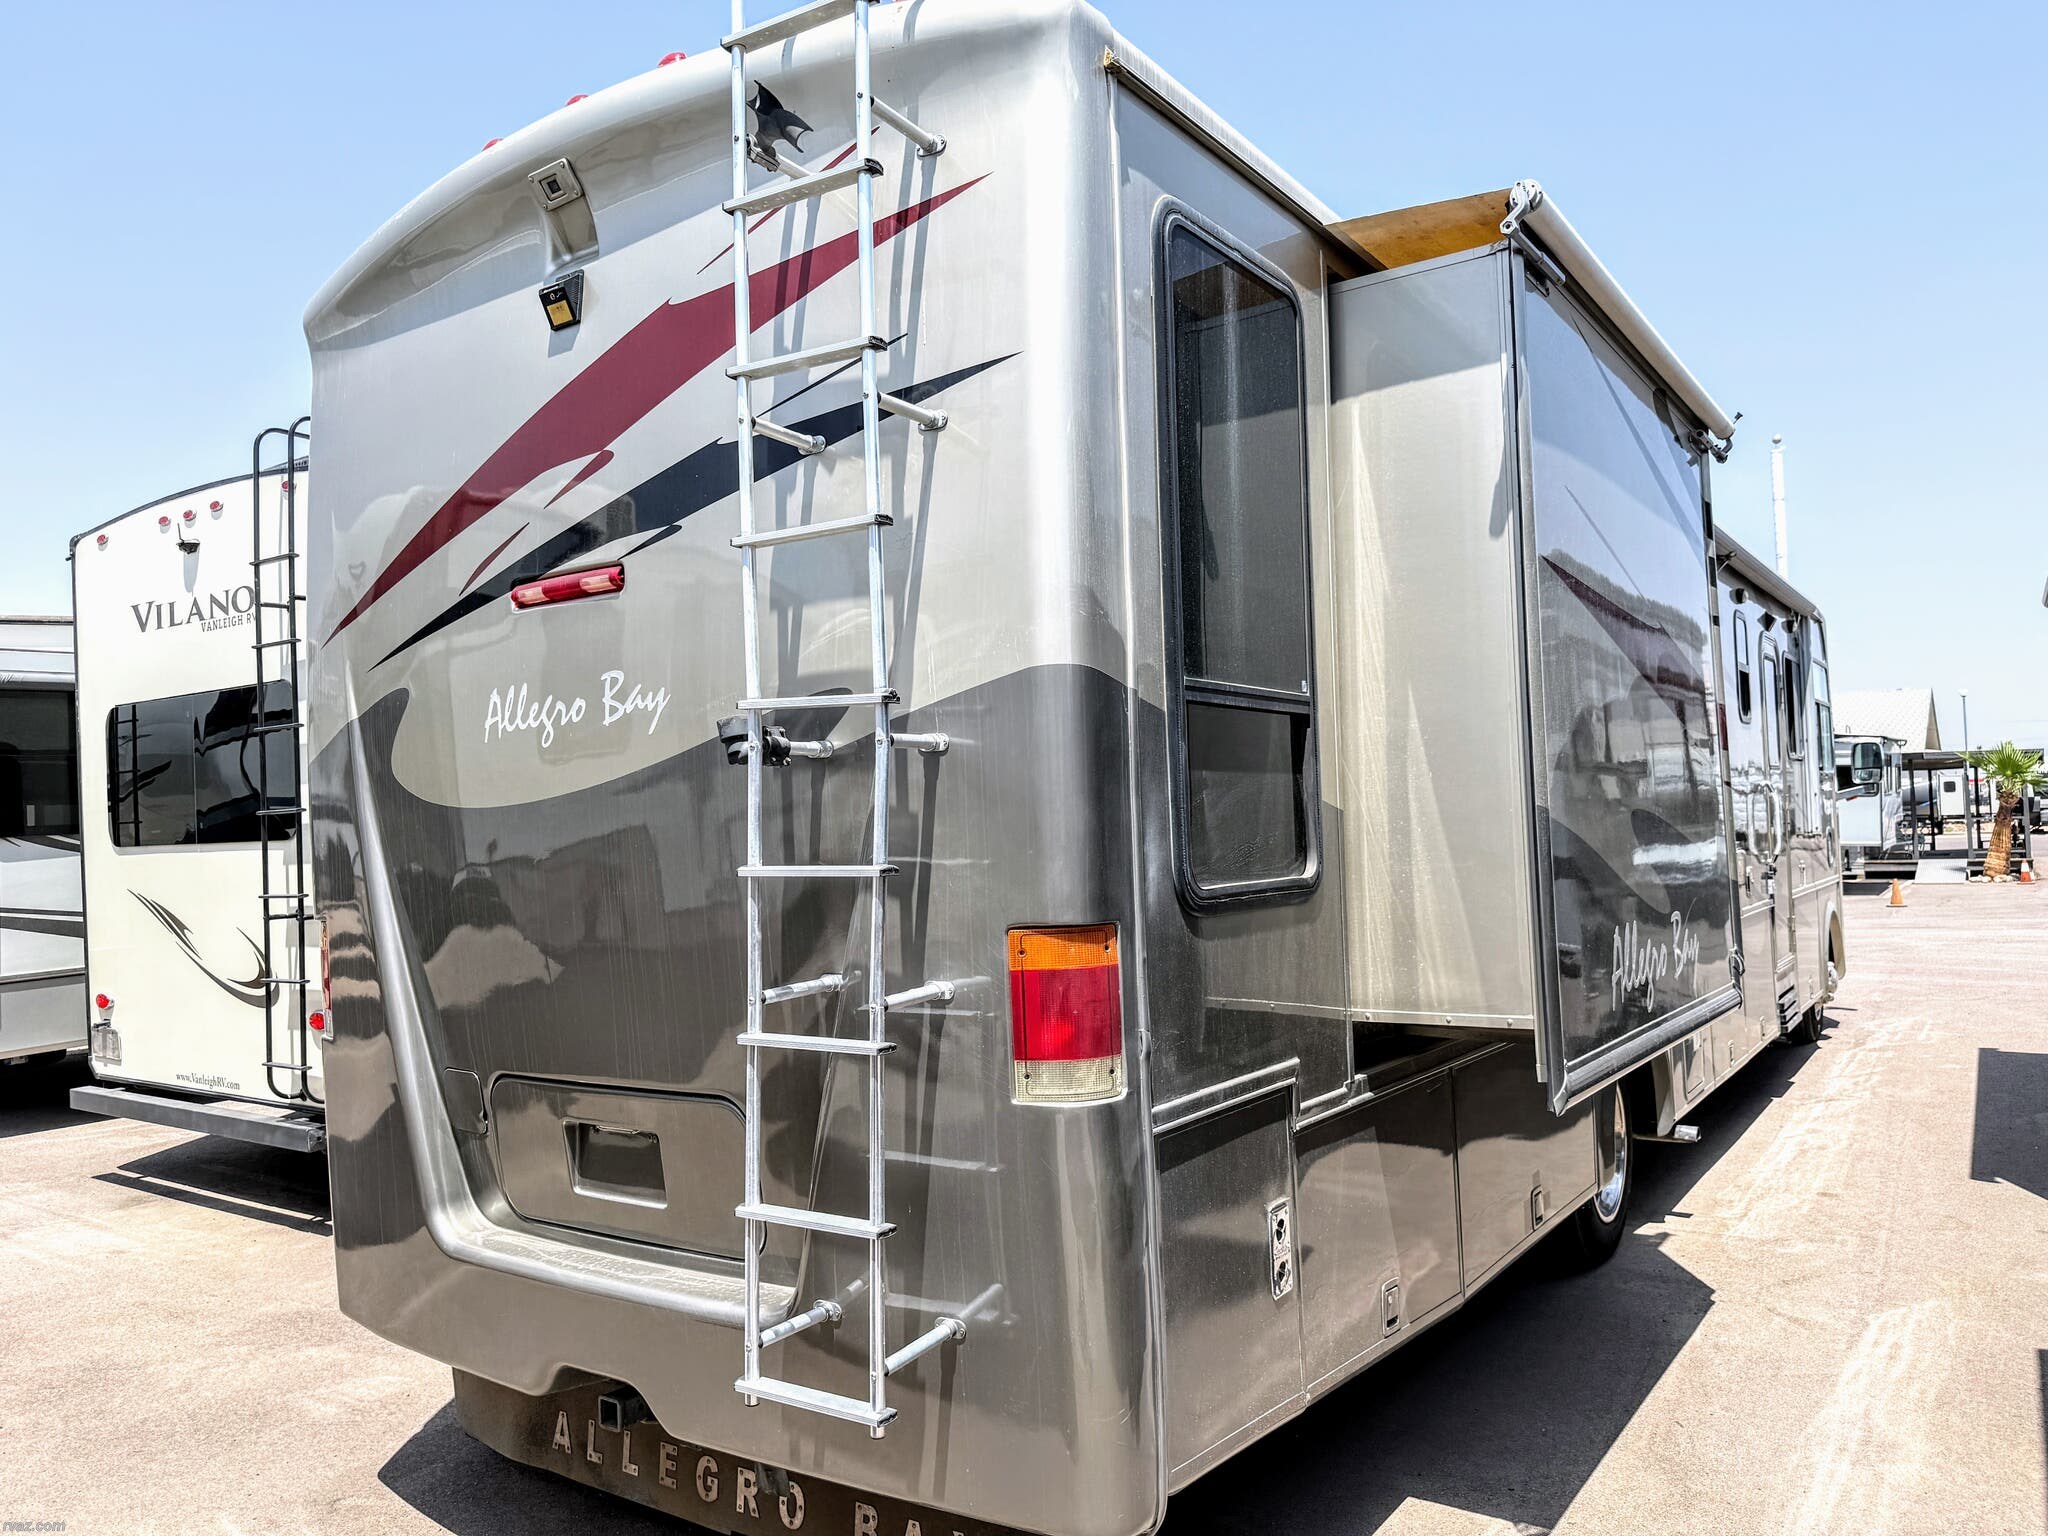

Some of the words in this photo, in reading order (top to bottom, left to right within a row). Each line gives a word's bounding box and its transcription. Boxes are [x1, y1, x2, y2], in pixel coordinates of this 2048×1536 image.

[130, 585, 255, 632] VILANO
[201, 617, 243, 632] VANLEIGH
[484, 682, 586, 748] Allegro
[600, 670, 671, 735] Bay
[1611, 920, 1668, 1013] Allegro
[1670, 910, 1700, 998] Bay
[176, 1072, 240, 1090] www.VanleighRV.com
[552, 1410, 805, 1530] ALLEGRO
